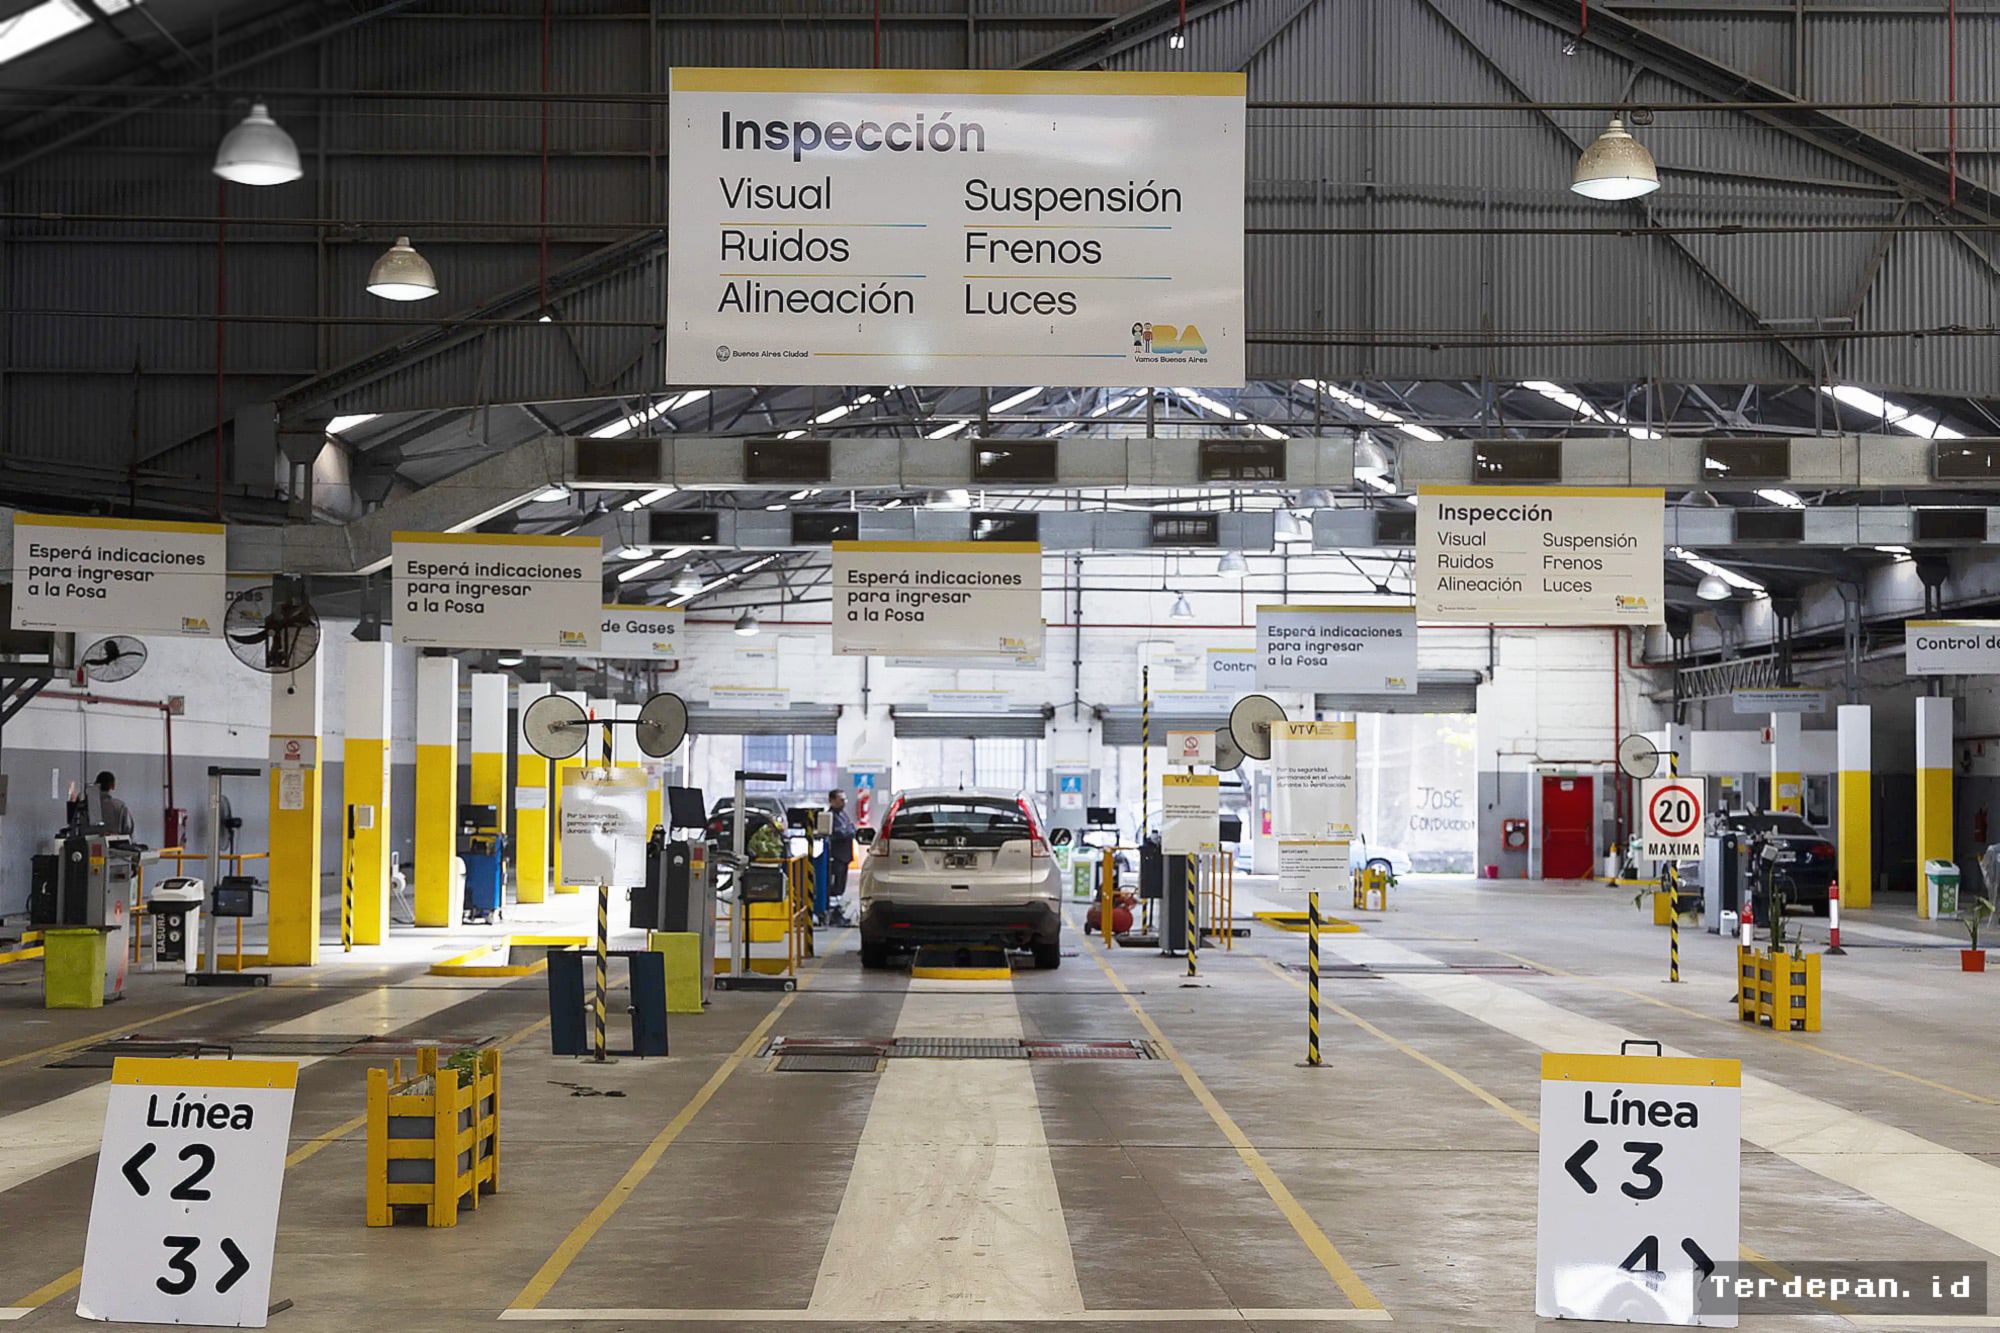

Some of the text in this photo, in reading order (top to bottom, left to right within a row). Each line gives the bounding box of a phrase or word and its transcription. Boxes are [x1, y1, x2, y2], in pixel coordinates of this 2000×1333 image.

[722, 111, 985, 162] Inspección
[719, 176, 831, 210] Visual
[965, 179, 1182, 220] Suspensión
[721, 229, 850, 262] Ruidos
[966, 233, 1102, 264] Frenos
[718, 281, 914, 314] Alineación
[966, 284, 1077, 315] Luces
[1439, 504, 1553, 525] Inspección
[1437, 531, 1486, 547] Visual
[1543, 532, 1638, 551] Suspensión
[29, 544, 206, 565] Esperá indicaciones
[1438, 554, 1494, 569] Ruidos
[1543, 556, 1603, 571] Frenos
[29, 565, 154, 583] para ingresar
[408, 561, 582, 579] Esperá indicaciones
[848, 570, 1022, 587] Esperá indicaciones
[28, 581, 106, 598] a la fosa
[408, 581, 532, 599] para ingresar
[1437, 576, 1522, 592] Alineación
[1543, 577, 1593, 593] Luces
[407, 598, 485, 613] a la fosa
[848, 589, 972, 607] para ingresar
[847, 607, 925, 621] a la fosa
[601, 619, 675, 634] de Gases
[1268, 625, 1403, 640] Esperá indicaciones
[1268, 640, 1364, 655] para ingresar
[1916, 635, 1980, 650] Control
[1268, 654, 1328, 666] a la fosa
[1290, 724, 1315, 735] VTV
[1659, 799, 1691, 823] 20
[1648, 843, 1700, 856] MAXIMA
[157, 913, 166, 953] BASURA
[147, 1092, 254, 1131] Línea
[1584, 1089, 1698, 1129] Línea
[170, 1143, 216, 1201] 2
[1620, 1141, 1664, 1201] 3
[156, 1236, 201, 1296] 3
[1618, 1235, 1667, 1292] 4
